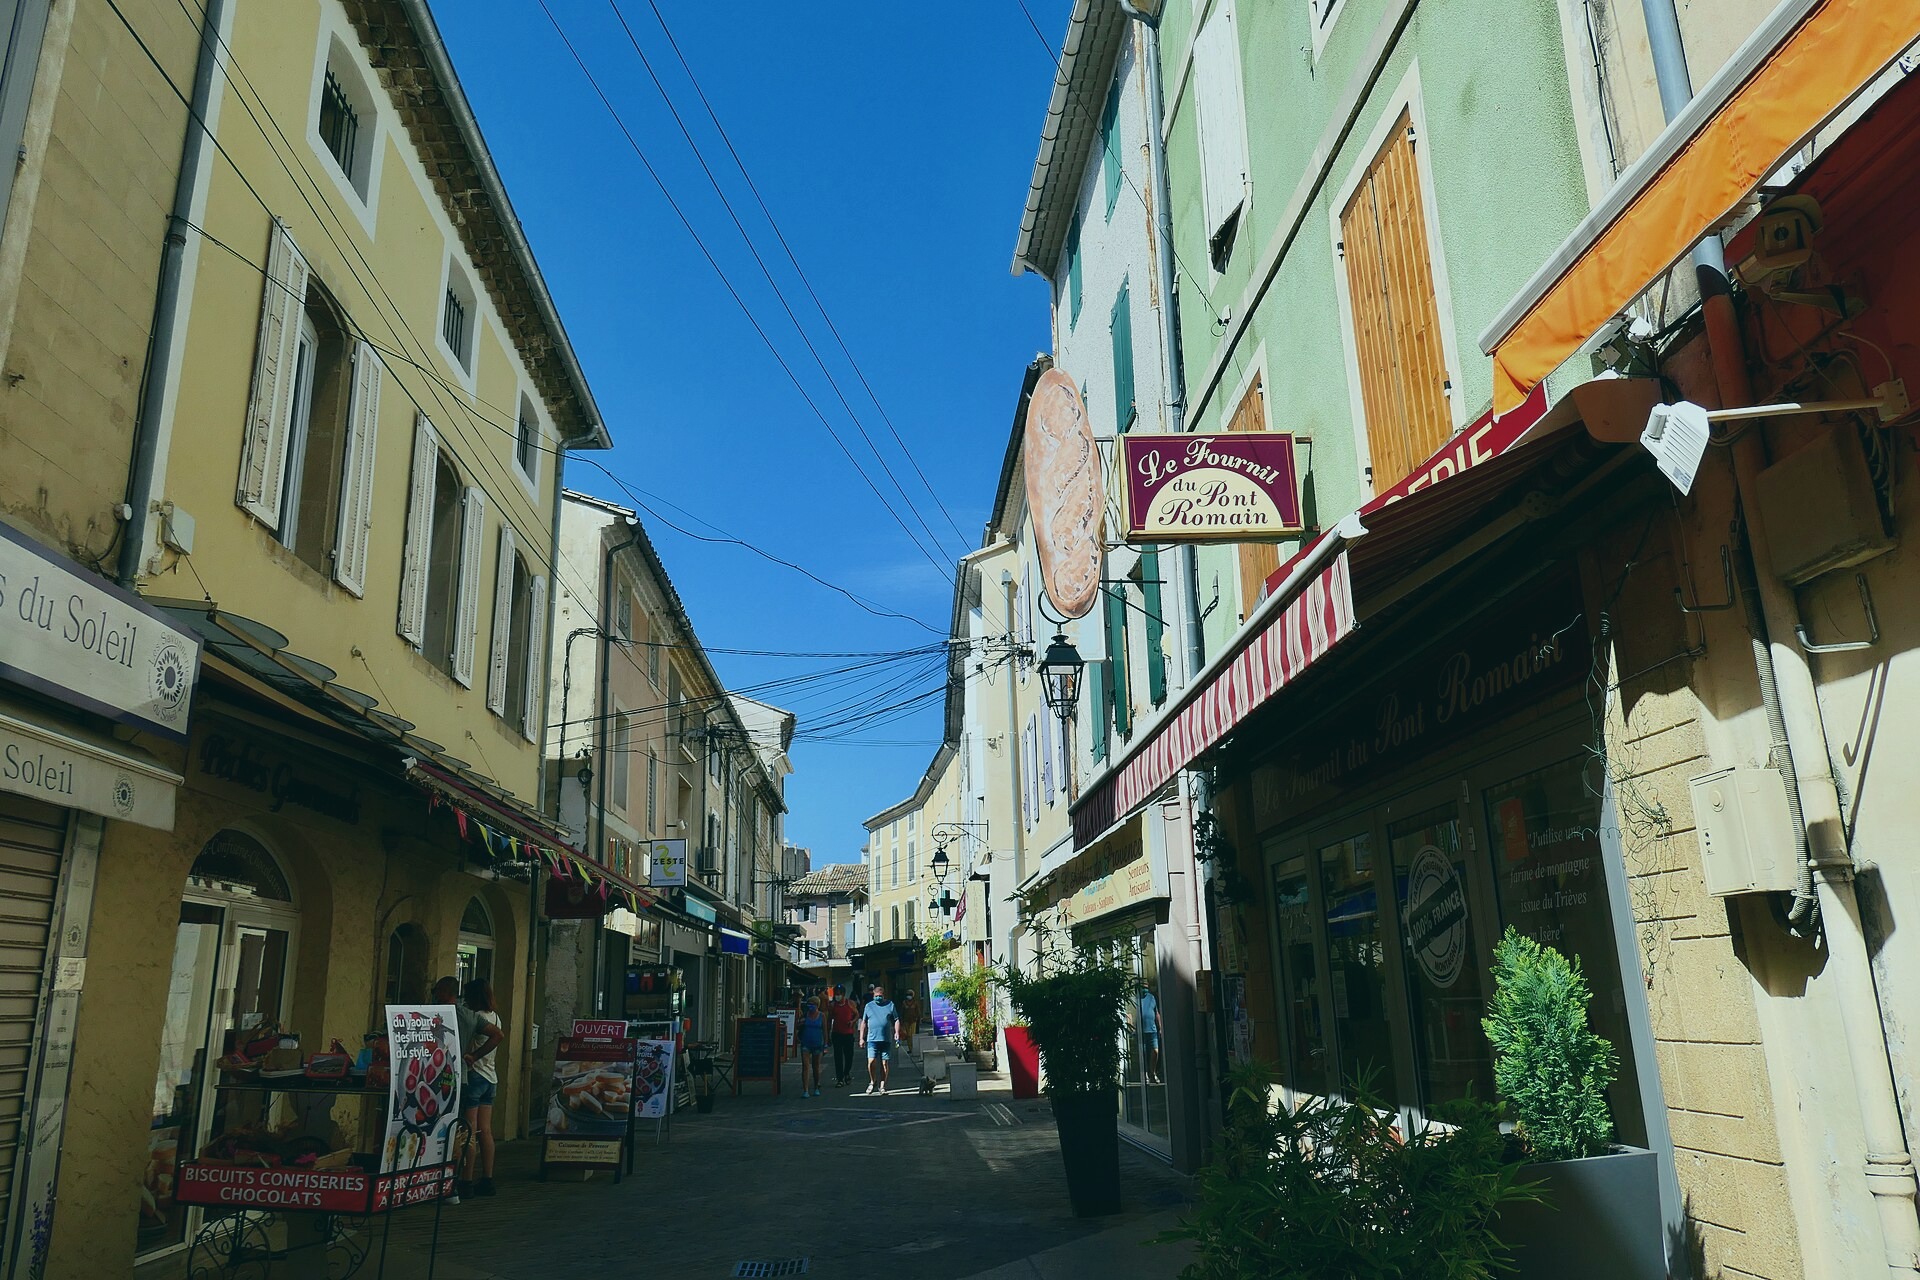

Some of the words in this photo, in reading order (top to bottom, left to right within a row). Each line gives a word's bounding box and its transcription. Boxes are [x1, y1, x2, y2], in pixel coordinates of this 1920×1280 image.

[1138, 449, 1178, 487] Le
[1183, 437, 1280, 485] Fournil
[1172, 478, 1197, 492] du
[1196, 480, 1258, 507] Pont
[1158, 498, 1269, 526] Romain
[19, 576, 54, 631] du
[63, 594, 138, 669] Soleil
[1285, 748, 1342, 803] Fournil
[1347, 738, 1370, 771] du
[1375, 690, 1425, 755] Pont
[1436, 632, 1563, 725] Romain
[3, 744, 73, 795] Soleil
[1510, 867, 1534, 889] farine
[1534, 862, 1546, 879] de
[1547, 857, 1590, 876] montagne
[1412, 912, 1433, 940] 100%
[1432, 890, 1461, 926] FRANCE
[1520, 898, 1541, 913] issue
[1542, 893, 1553, 910] du
[1555, 889, 1588, 908] Trièves
[393, 1016, 405, 1028] du
[405, 1017, 437, 1031] yaourt,
[395, 1032, 410, 1043] des
[411, 1031, 436, 1043] fruits,
[575, 1023, 622, 1036] OUVERT
[396, 1047, 408, 1059] du
[409, 1046, 432, 1061] style.
[185, 1167, 255, 1184] BISCUITS
[259, 1170, 364, 1192] CONFISERIES
[219, 1186, 322, 1207] CHOCOLATS
